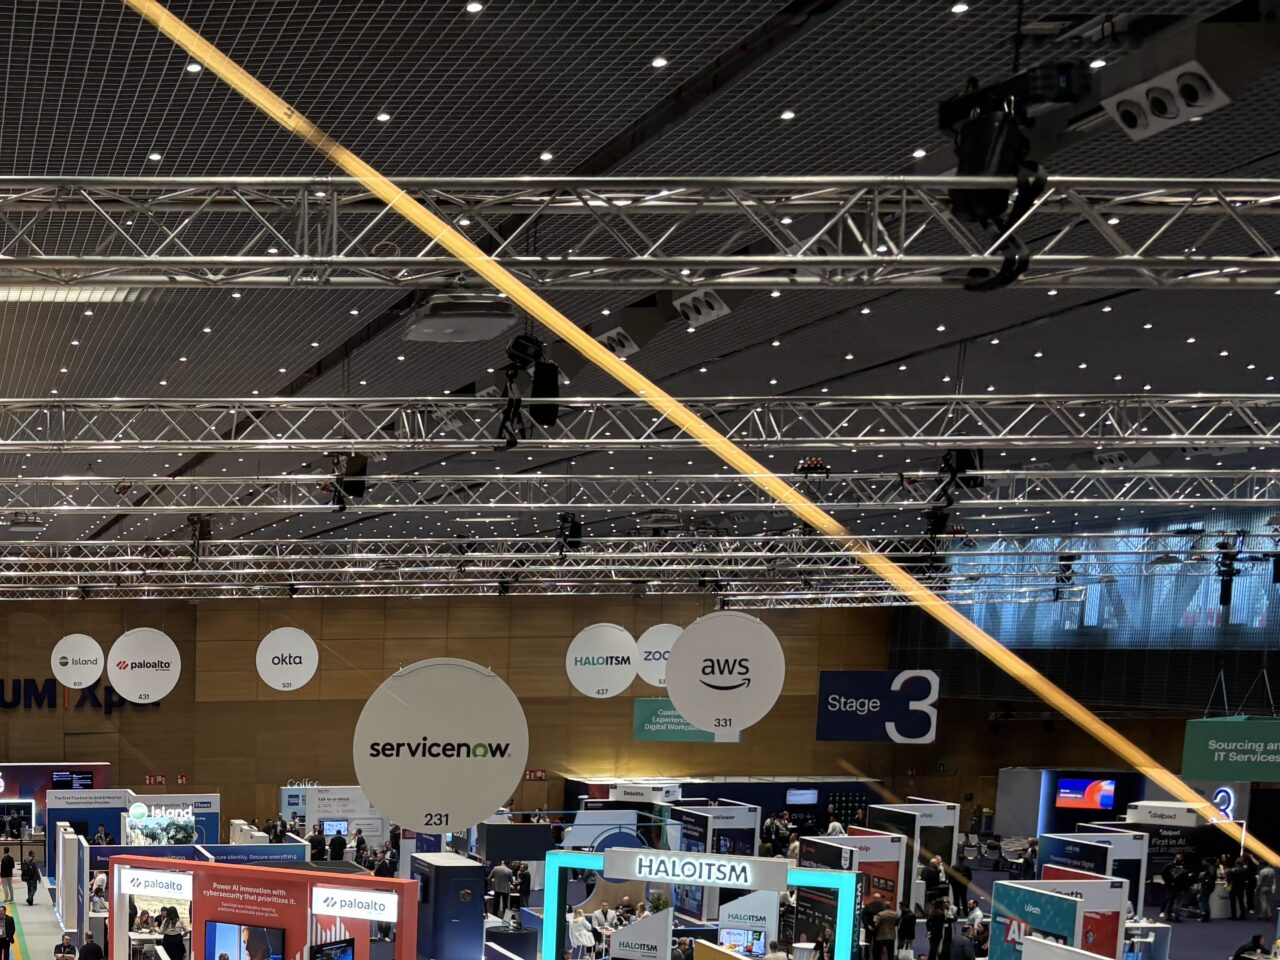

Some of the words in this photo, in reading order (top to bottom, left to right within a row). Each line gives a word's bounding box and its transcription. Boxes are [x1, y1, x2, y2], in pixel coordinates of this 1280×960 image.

[71, 656, 98, 666] island
[130, 659, 170, 672] paloalto
[271, 653, 303, 666] okta
[574, 655, 631, 667] HALOITSM
[701, 657, 750, 675] aws
[827, 694, 881, 712] Stage
[884, 669, 940, 745] 3
[644, 723, 666, 731] Digital
[713, 718, 732, 728] 331
[369, 736, 511, 759] servicenow
[1207, 739, 1259, 753] Sourcing
[1214, 752, 1226, 763] IT
[1227, 751, 1280, 763] Services
[623, 789, 644, 797] Deloitte.
[151, 804, 193, 819] Island
[1150, 811, 1177, 820] dialpad
[423, 813, 450, 826] 231
[1151, 837, 1168, 846] First
[229, 854, 248, 862] identity.
[269, 854, 298, 862] everything.
[638, 857, 748, 884] HALOITSM
[144, 879, 183, 891] paloalto
[212, 882, 231, 890] Power
[239, 885, 272, 895] innovation
[202, 889, 243, 901] cybersecurity
[257, 895, 289, 904] prioritizes
[339, 897, 387, 913] paloalto
[727, 912, 767, 924] HALOITSM
[618, 940, 658, 953] HALOITSM
